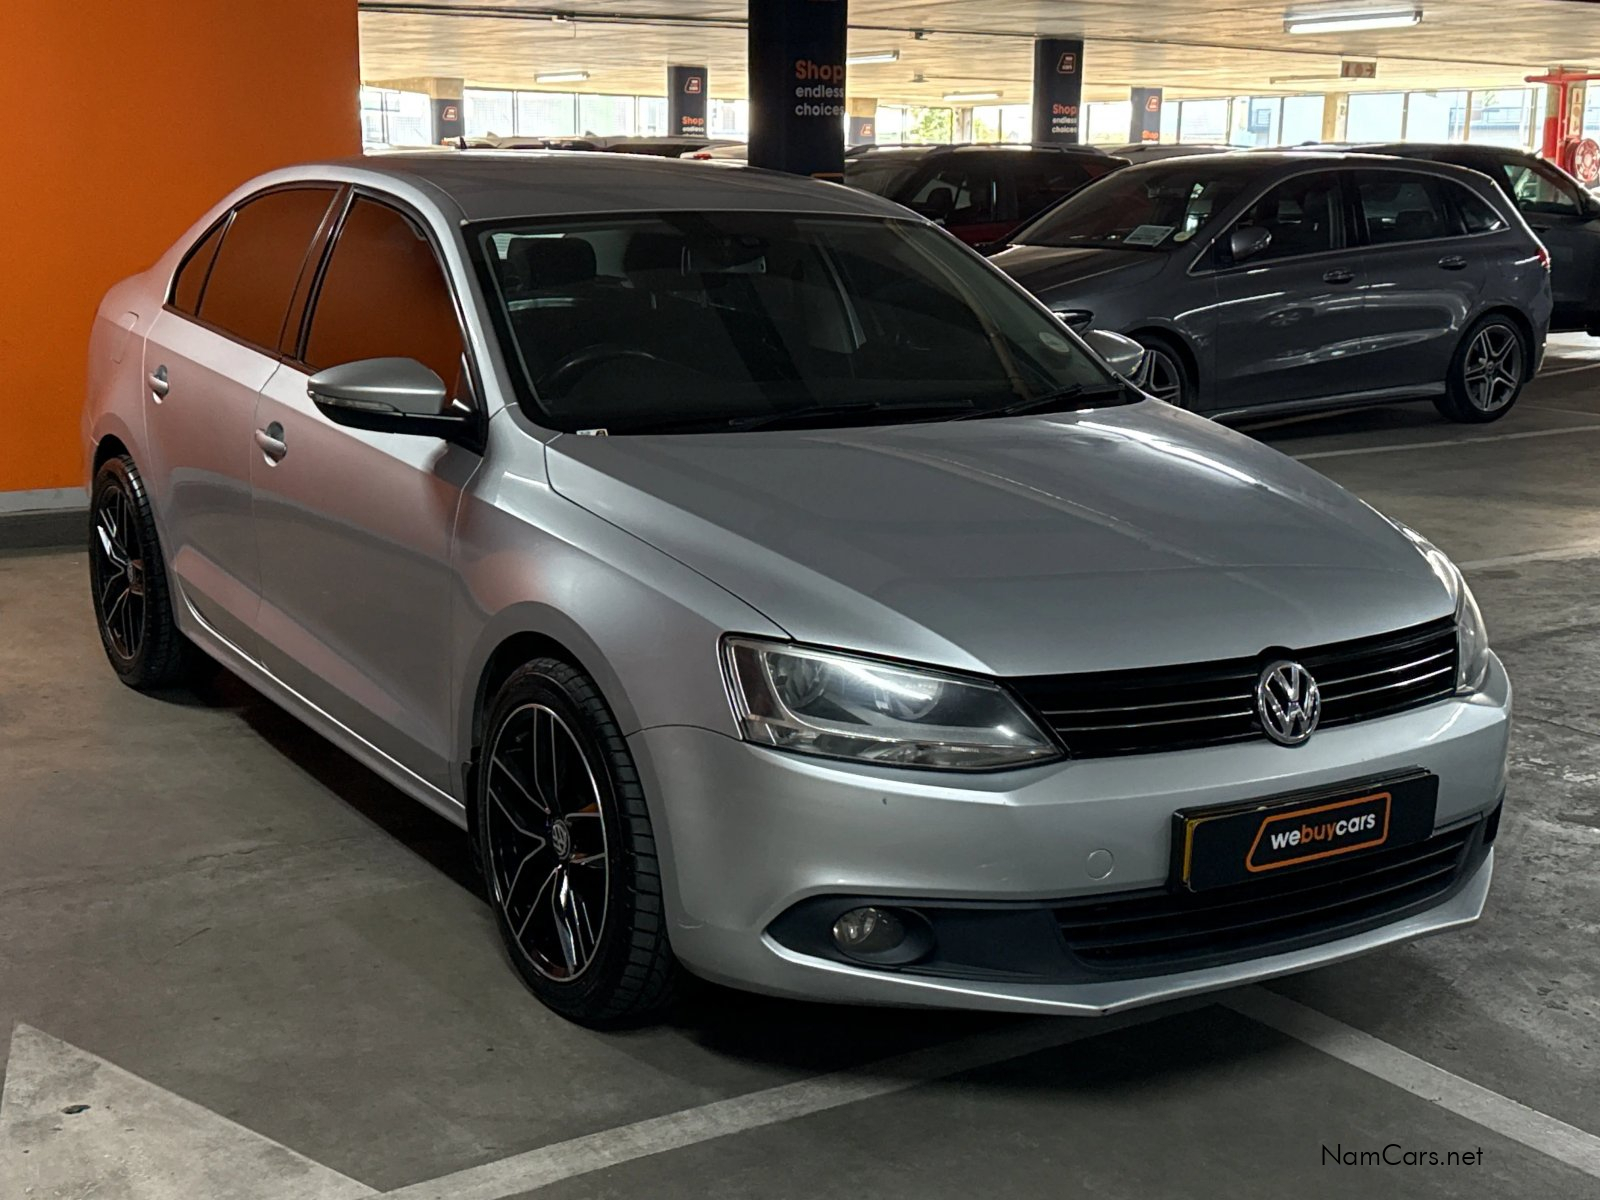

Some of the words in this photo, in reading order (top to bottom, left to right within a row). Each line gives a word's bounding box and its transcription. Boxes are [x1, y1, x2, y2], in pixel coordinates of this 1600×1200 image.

[795, 59, 844, 84] Shop
[795, 84, 844, 98] endless
[795, 102, 844, 116] choices
[1052, 103, 1077, 116] Shop
[682, 115, 704, 126] Shop
[1270, 813, 1376, 850] webuycars
